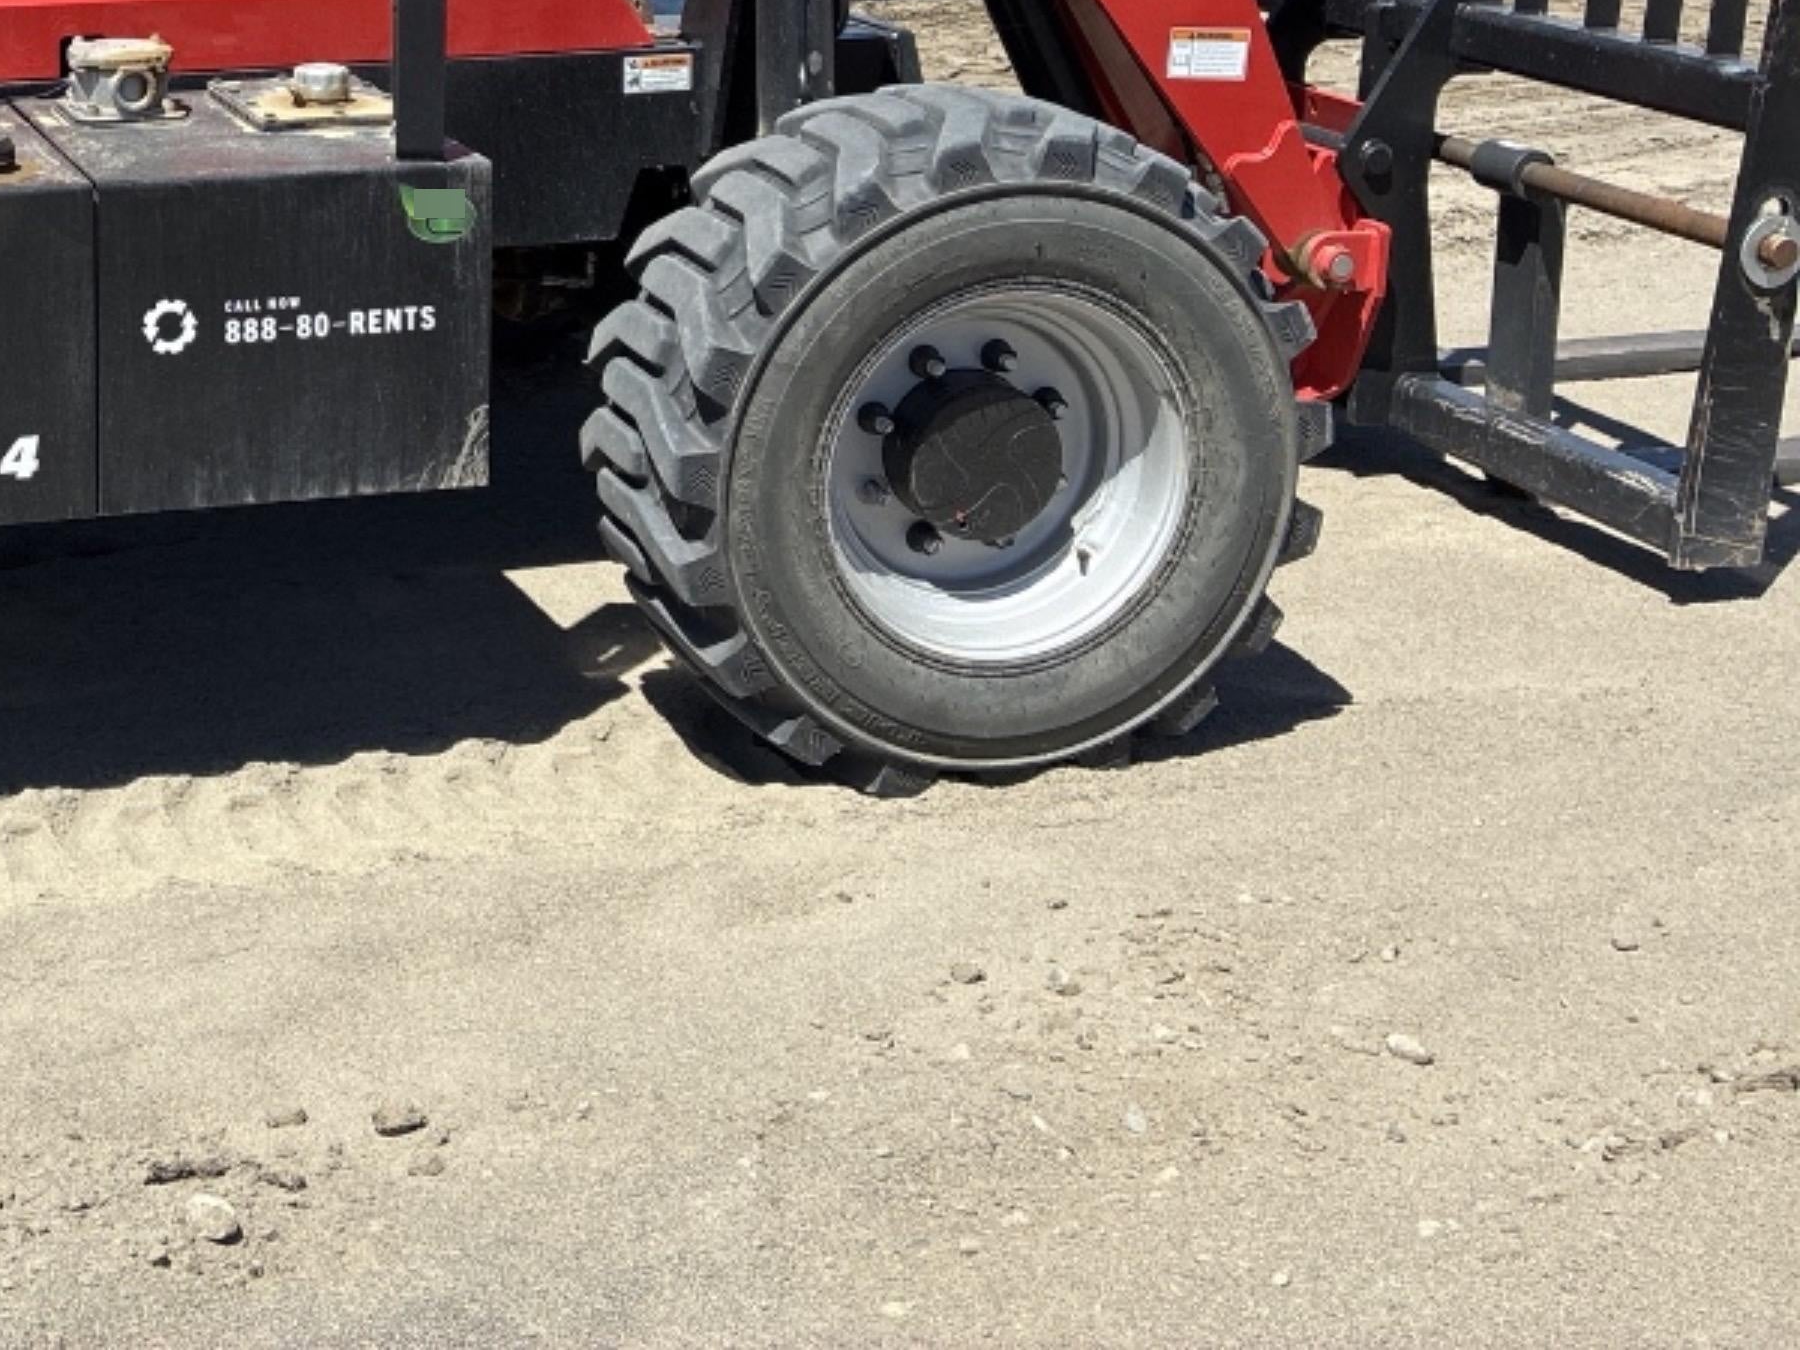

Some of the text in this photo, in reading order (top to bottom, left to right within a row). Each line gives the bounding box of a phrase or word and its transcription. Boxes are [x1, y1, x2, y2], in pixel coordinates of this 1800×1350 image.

[223, 296, 301, 313] CALL NOW
[223, 305, 437, 344] 888-80-RENTS
